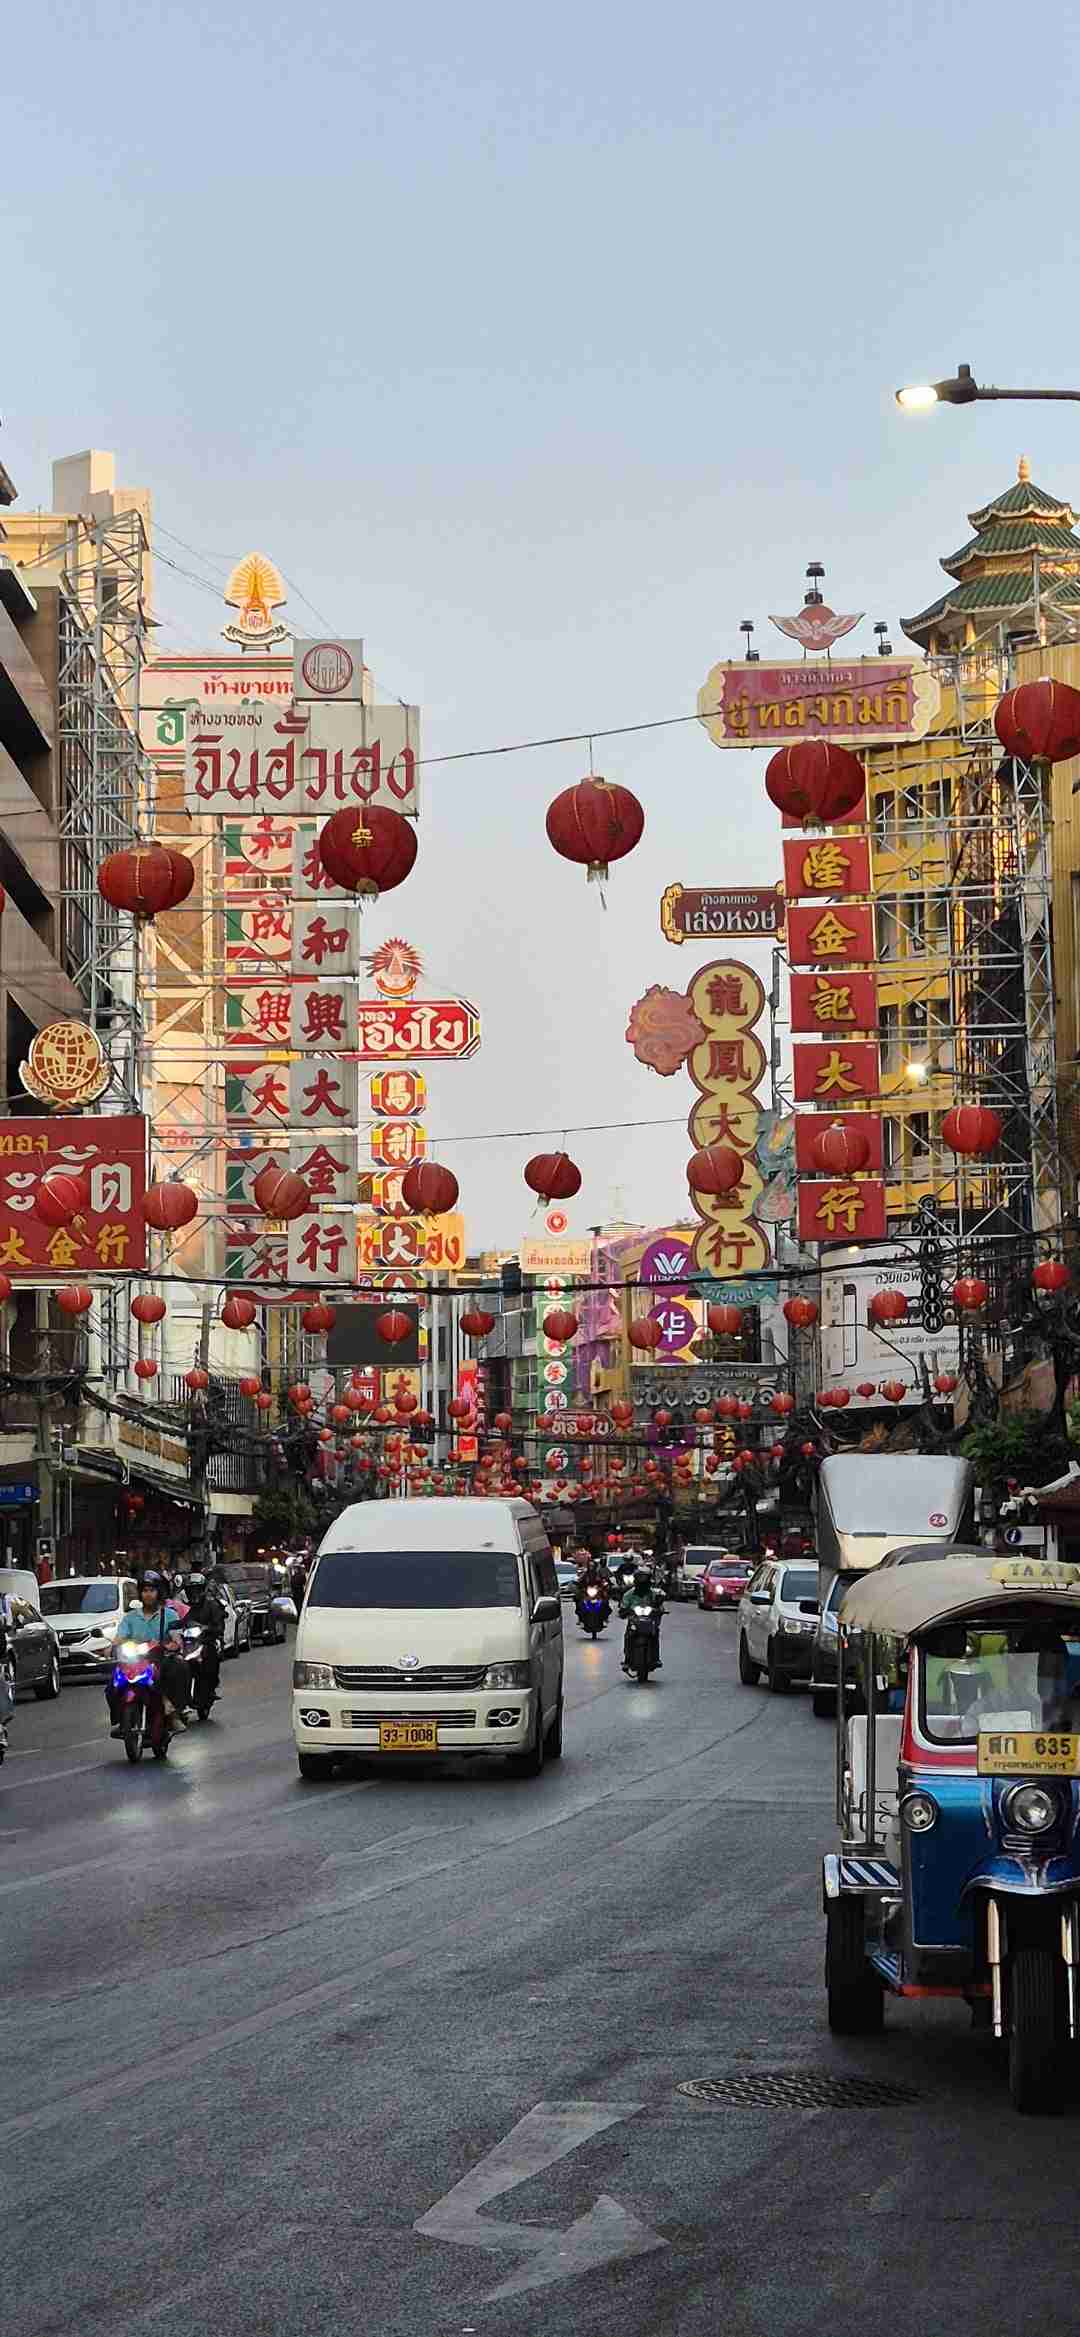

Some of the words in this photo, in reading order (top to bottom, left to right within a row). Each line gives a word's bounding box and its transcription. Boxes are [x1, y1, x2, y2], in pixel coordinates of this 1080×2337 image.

[802, 842, 866, 1232] 隆金記大行
[1034, 1736, 1072, 1756] 635
